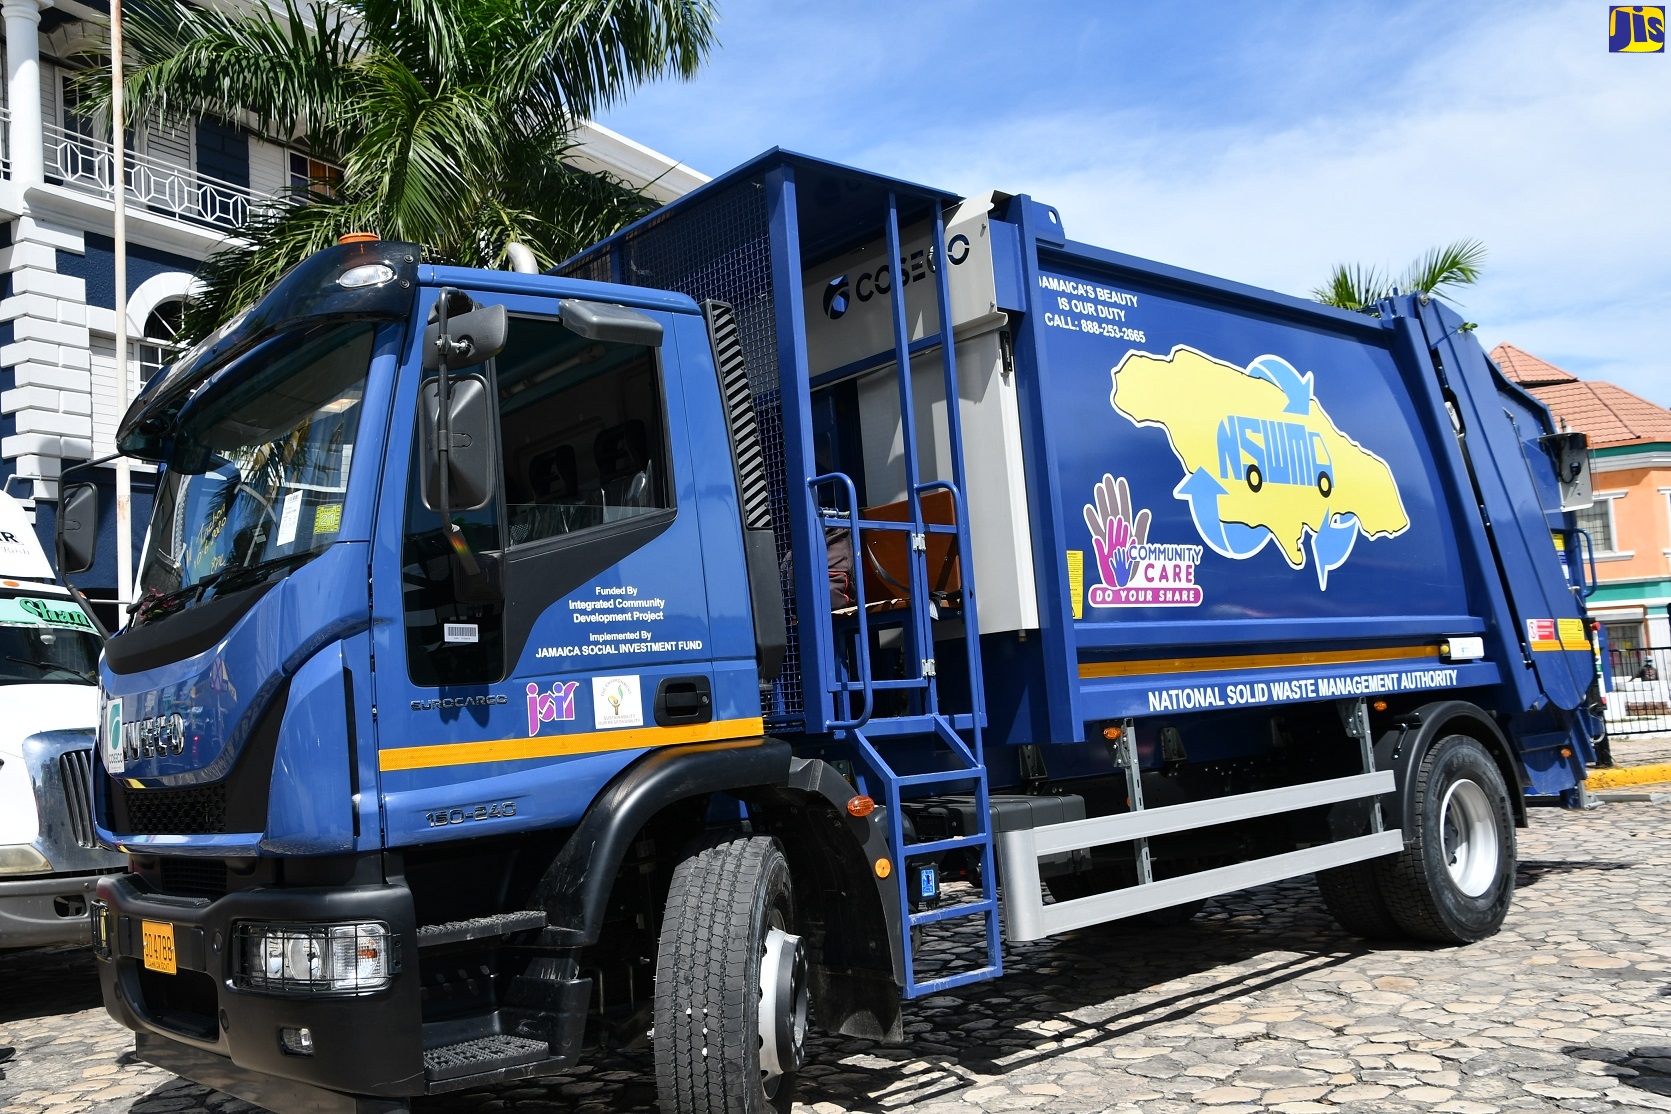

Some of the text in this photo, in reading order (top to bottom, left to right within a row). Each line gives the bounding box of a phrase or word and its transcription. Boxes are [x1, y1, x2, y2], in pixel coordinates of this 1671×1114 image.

[1095, 287, 1138, 308] BEAUTY
[1057, 296, 1126, 322] IS OUR DUTY
[1044, 312, 1146, 343] CALL: 888-253-2665
[320, 513, 334, 525] 21
[1129, 545, 1202, 562] COMMUNITY
[1144, 563, 1193, 583] CARE
[595, 586, 638, 596] Funded By
[1096, 590, 1195, 601] DO YOUR SHARE
[569, 597, 665, 611] Integrated Community
[573, 611, 664, 624] Development Project
[590, 630, 652, 642] Implemented By
[535, 640, 703, 658] JAMAICA SOCIAL INVESTMENT FUND
[1148, 669, 1458, 712] NATIONAL SOLID WASTE MANAGEMENT AUTHORITY
[410, 694, 508, 711] EUROCARGO
[426, 801, 517, 827] 150-240
